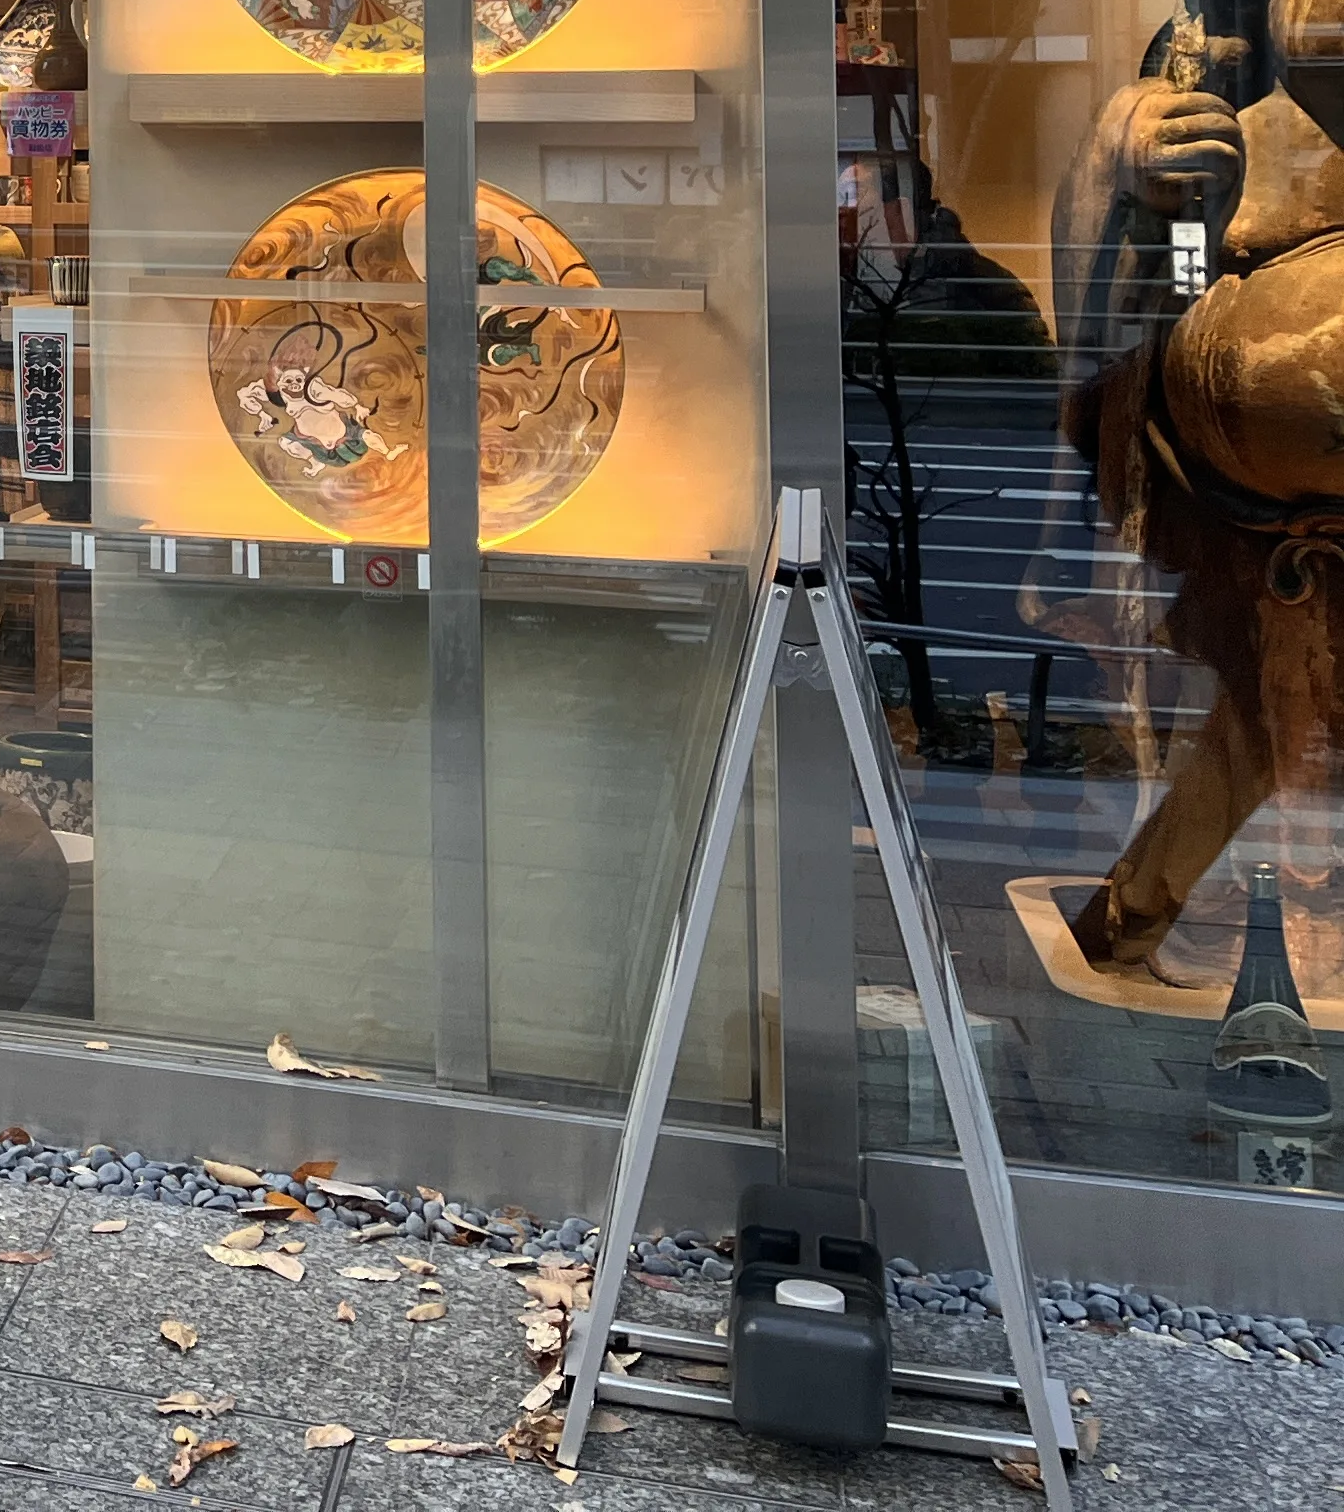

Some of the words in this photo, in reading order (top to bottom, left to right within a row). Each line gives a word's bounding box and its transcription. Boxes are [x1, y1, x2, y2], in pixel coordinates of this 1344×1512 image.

[18, 107, 64, 118] ハッピー
[11, 119, 68, 138] 買物券
